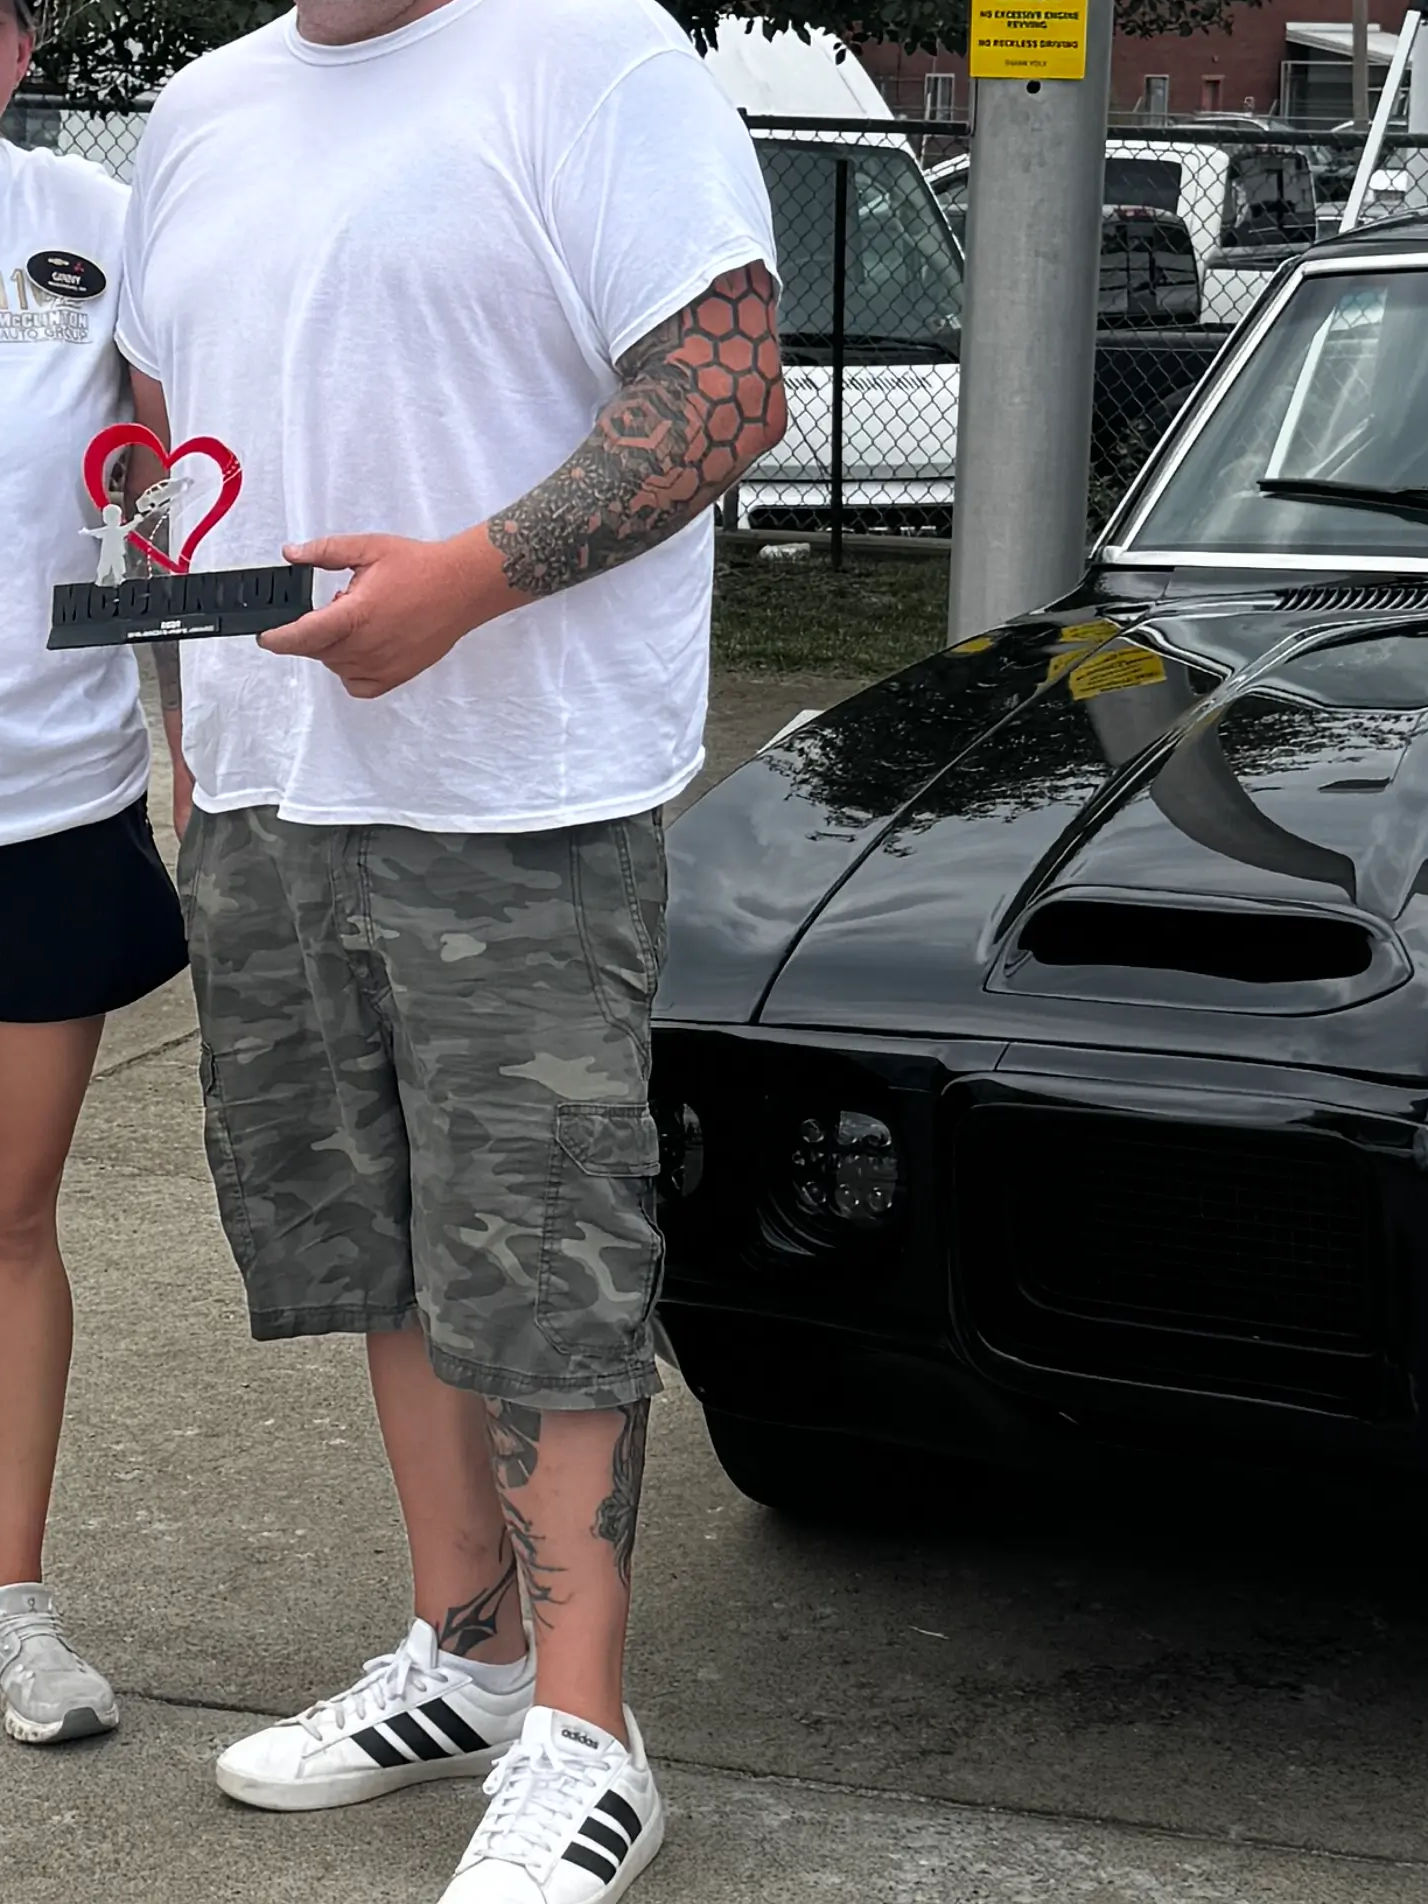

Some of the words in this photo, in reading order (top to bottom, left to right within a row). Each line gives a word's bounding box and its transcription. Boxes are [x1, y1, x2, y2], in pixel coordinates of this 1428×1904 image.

[980, 10, 992, 19] NO
[994, 10, 1042, 19] EXCESSIVE
[1044, 11, 1079, 20] ENGINE
[978, 39, 991, 47] NO
[993, 39, 1038, 48] RECKLESS
[1040, 39, 1078, 49] DRIVING
[0, 328, 39, 340] AUTO
[44, 326, 89, 341] GROUP
[561, 1728, 599, 1750] adidas
